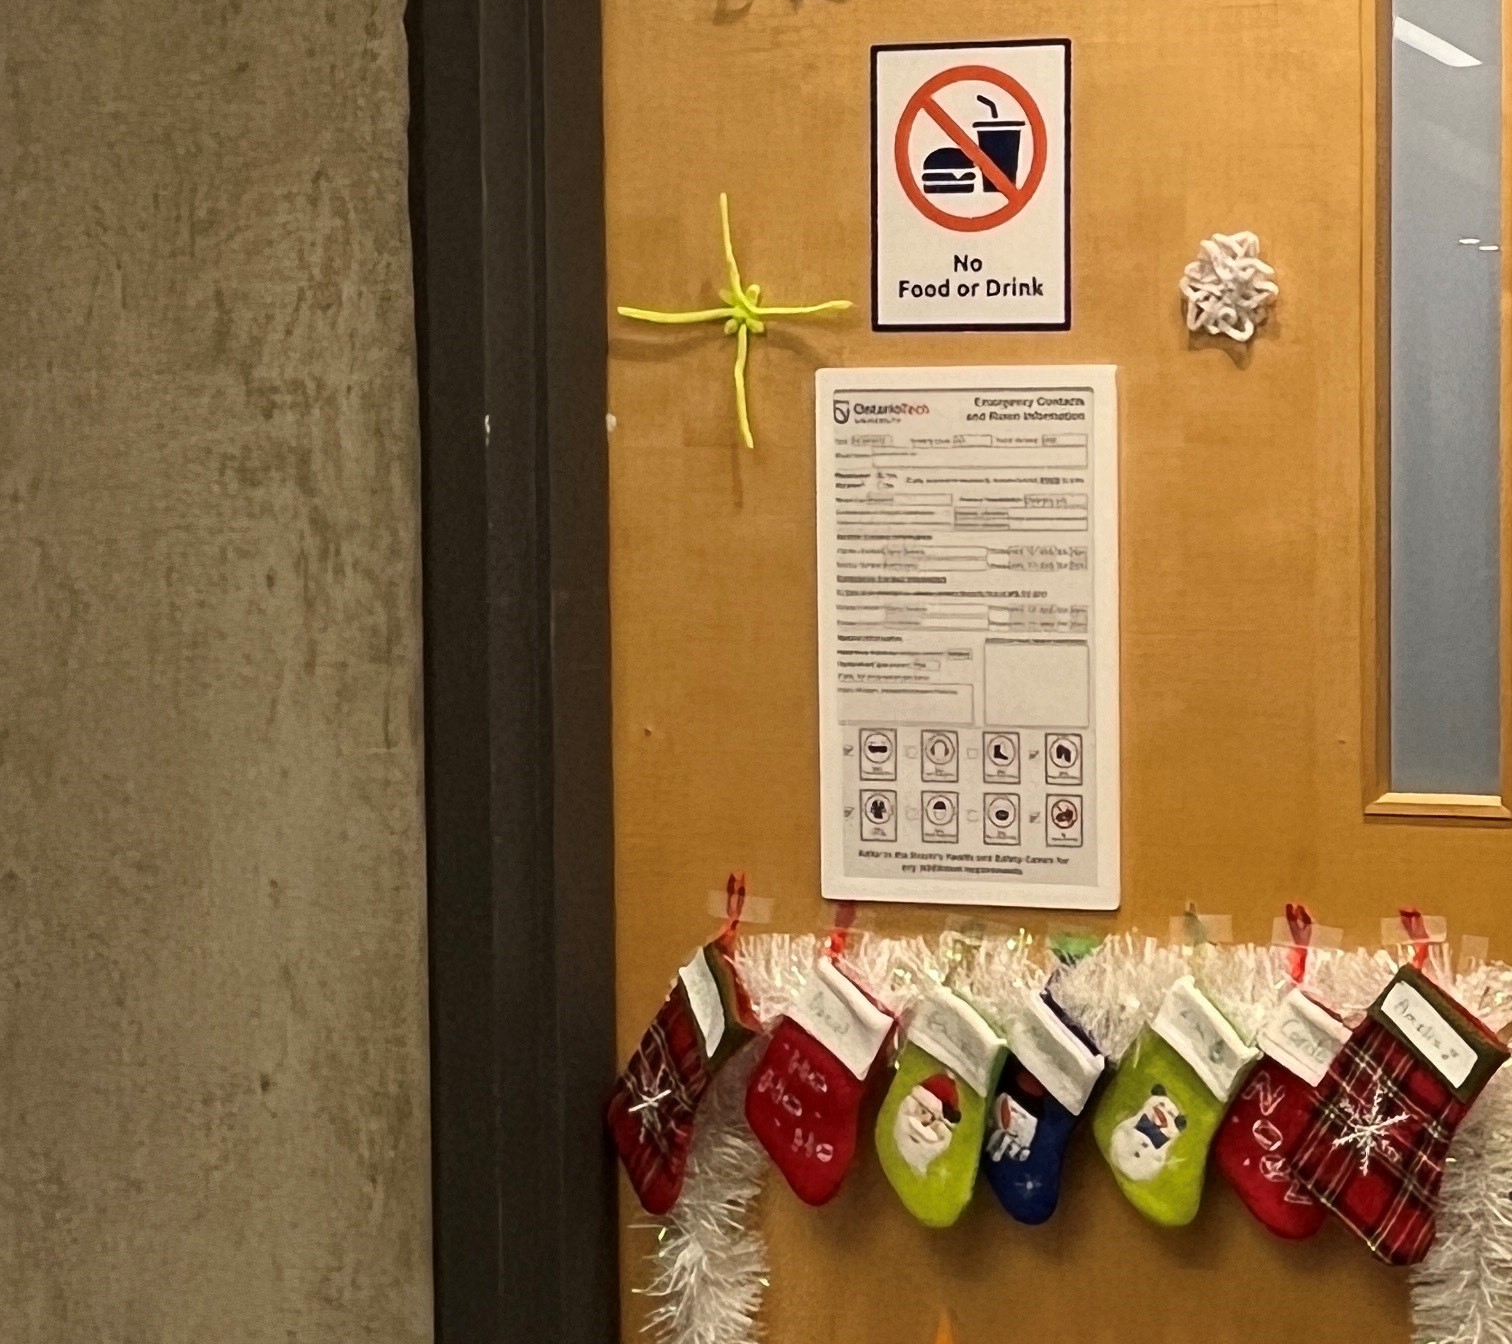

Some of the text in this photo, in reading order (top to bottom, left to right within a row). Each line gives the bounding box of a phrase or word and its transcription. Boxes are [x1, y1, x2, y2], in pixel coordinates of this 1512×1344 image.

[953, 254, 982, 272] No
[898, 276, 1044, 298] Food or Drink
